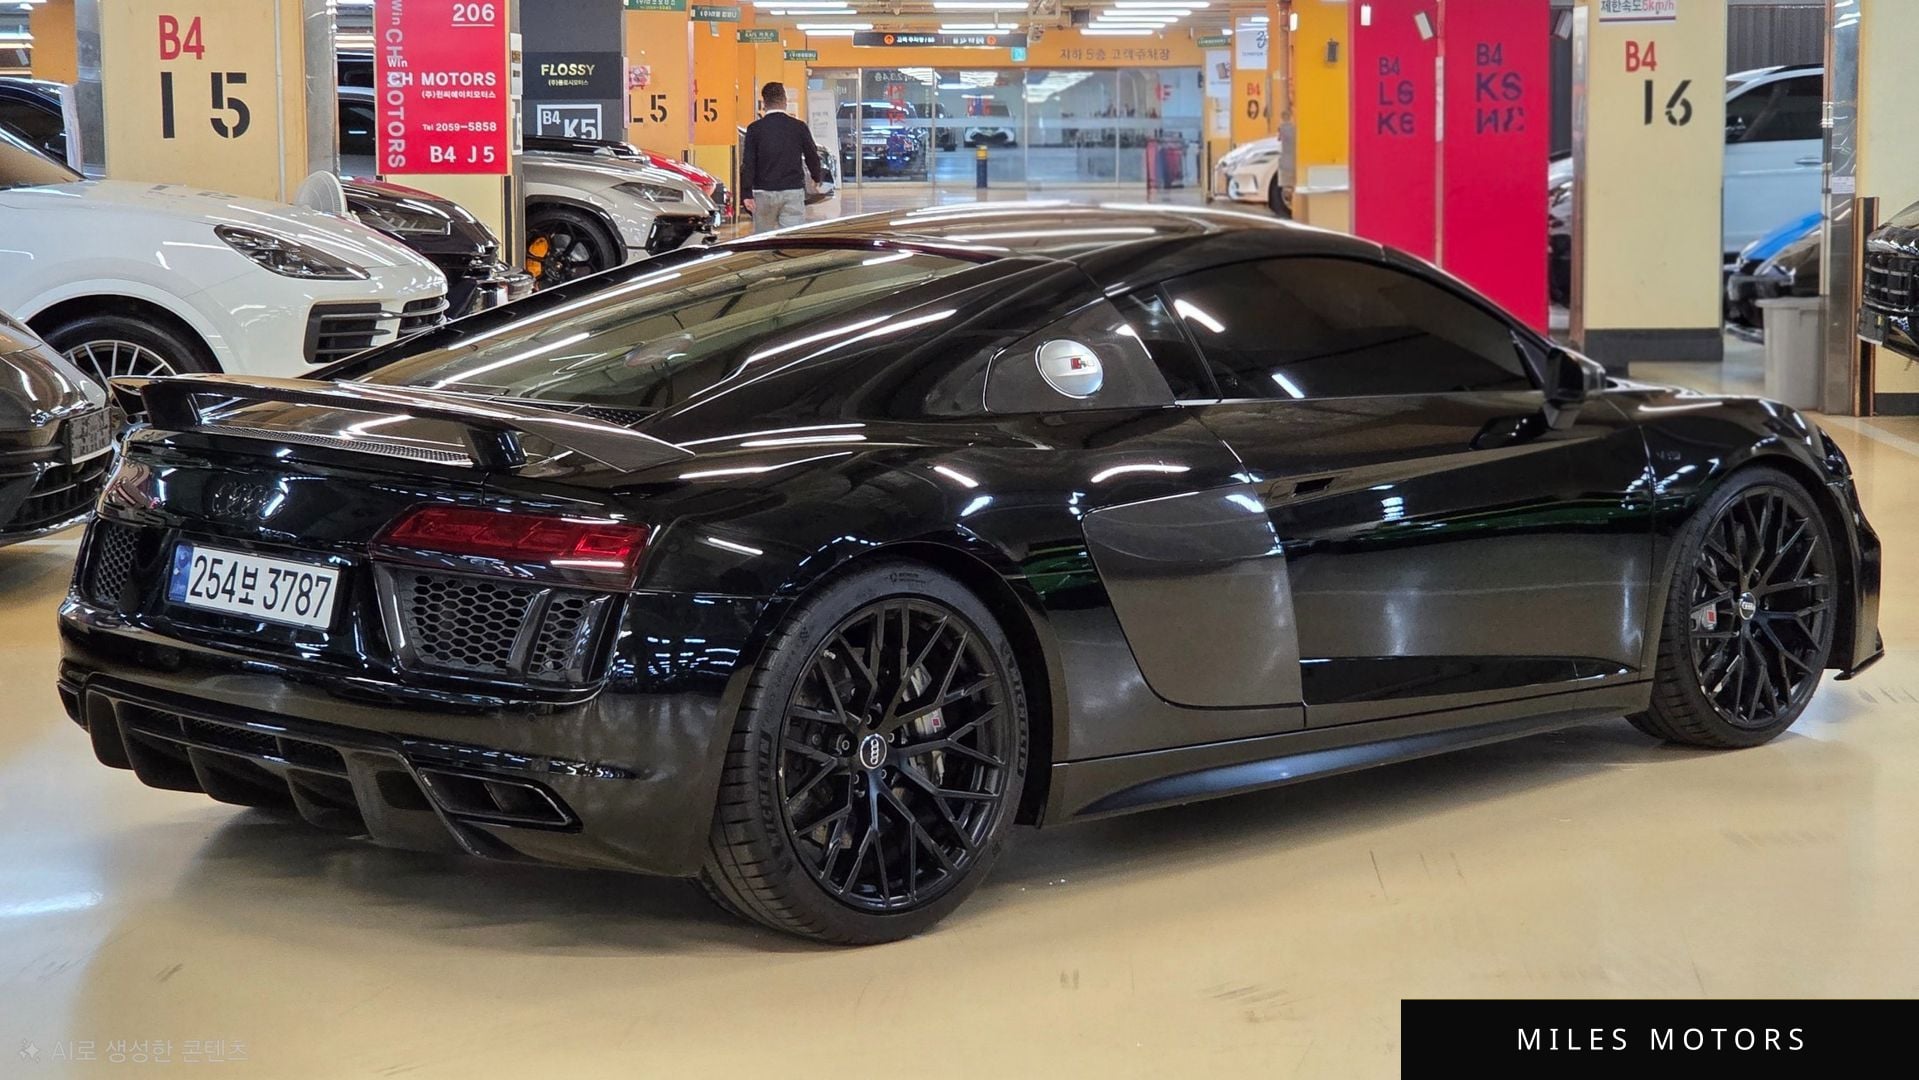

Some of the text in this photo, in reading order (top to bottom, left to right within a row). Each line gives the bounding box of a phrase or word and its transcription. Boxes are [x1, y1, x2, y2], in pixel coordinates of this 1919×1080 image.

[452, 3, 495, 22] 206
[158, 15, 205, 60] B4
[1476, 43, 1503, 66] B4
[1626, 40, 1658, 72] B4
[541, 63, 596, 76] FLOSSY
[1378, 56, 1401, 76] B4
[421, 71, 497, 86] MOTORS
[436, 121, 497, 132] 2059-5858
[542, 110, 561, 125] B4
[564, 118, 597, 140] K5
[429, 145, 457, 163] B4
